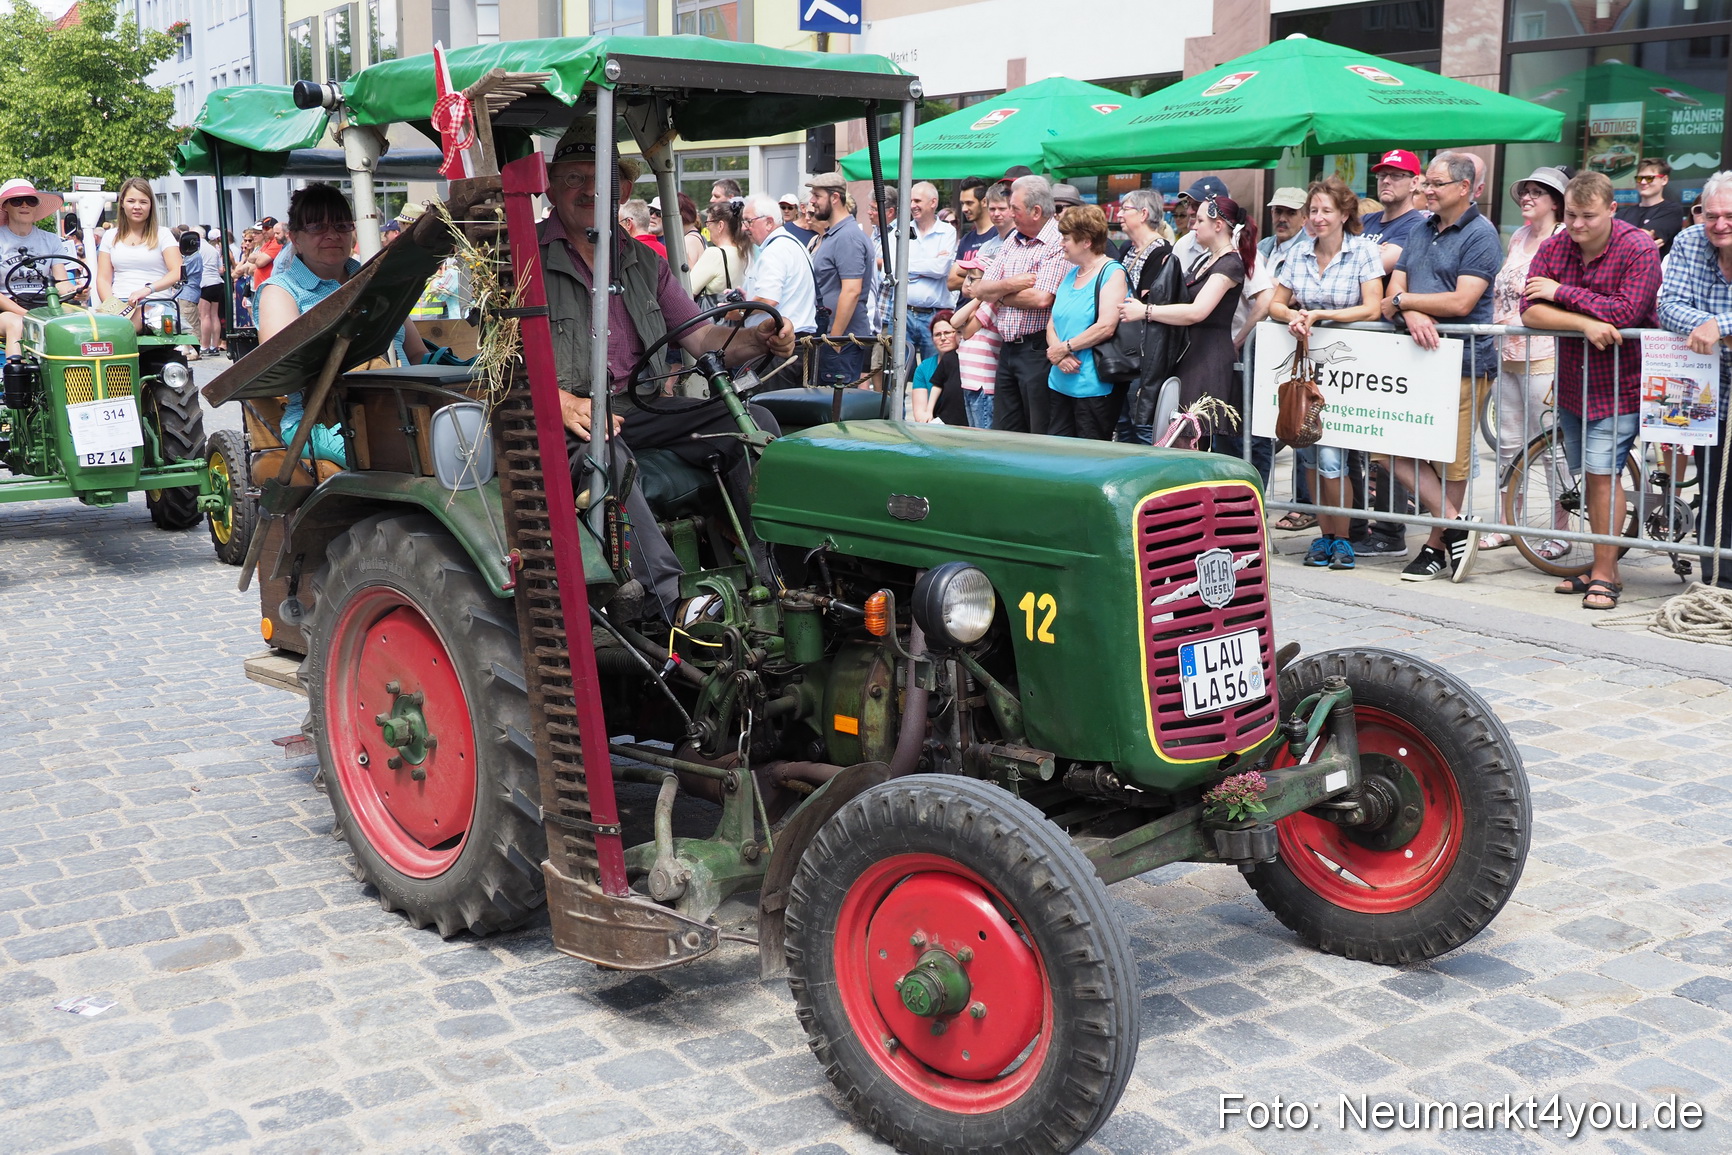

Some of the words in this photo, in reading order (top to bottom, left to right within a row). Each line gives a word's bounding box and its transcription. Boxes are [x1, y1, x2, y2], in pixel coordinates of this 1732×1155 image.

[910, 48, 918, 61] 15
[1160, 97, 1243, 111] Neumarkter
[1128, 104, 1243, 125] Lammsbräu
[1672, 106, 1724, 123] MÄNNER
[1592, 120, 1638, 134] OLDTIMER
[1670, 122, 1724, 135] SACHE(N)
[937, 131, 999, 141] Neumarkter
[912, 140, 998, 150] Lammsbräu
[85, 342, 110, 353] Bautz
[1645, 352, 1688, 360] Ausstellung
[1314, 362, 1408, 394] Express
[103, 408, 125, 421] 314
[87, 452, 106, 465] BZ
[110, 451, 126, 464] 14
[1205, 584, 1232, 597] DIESEL
[1018, 591, 1057, 644] 12
[1203, 638, 1244, 674] LAU
[1186, 665, 1192, 676] D
